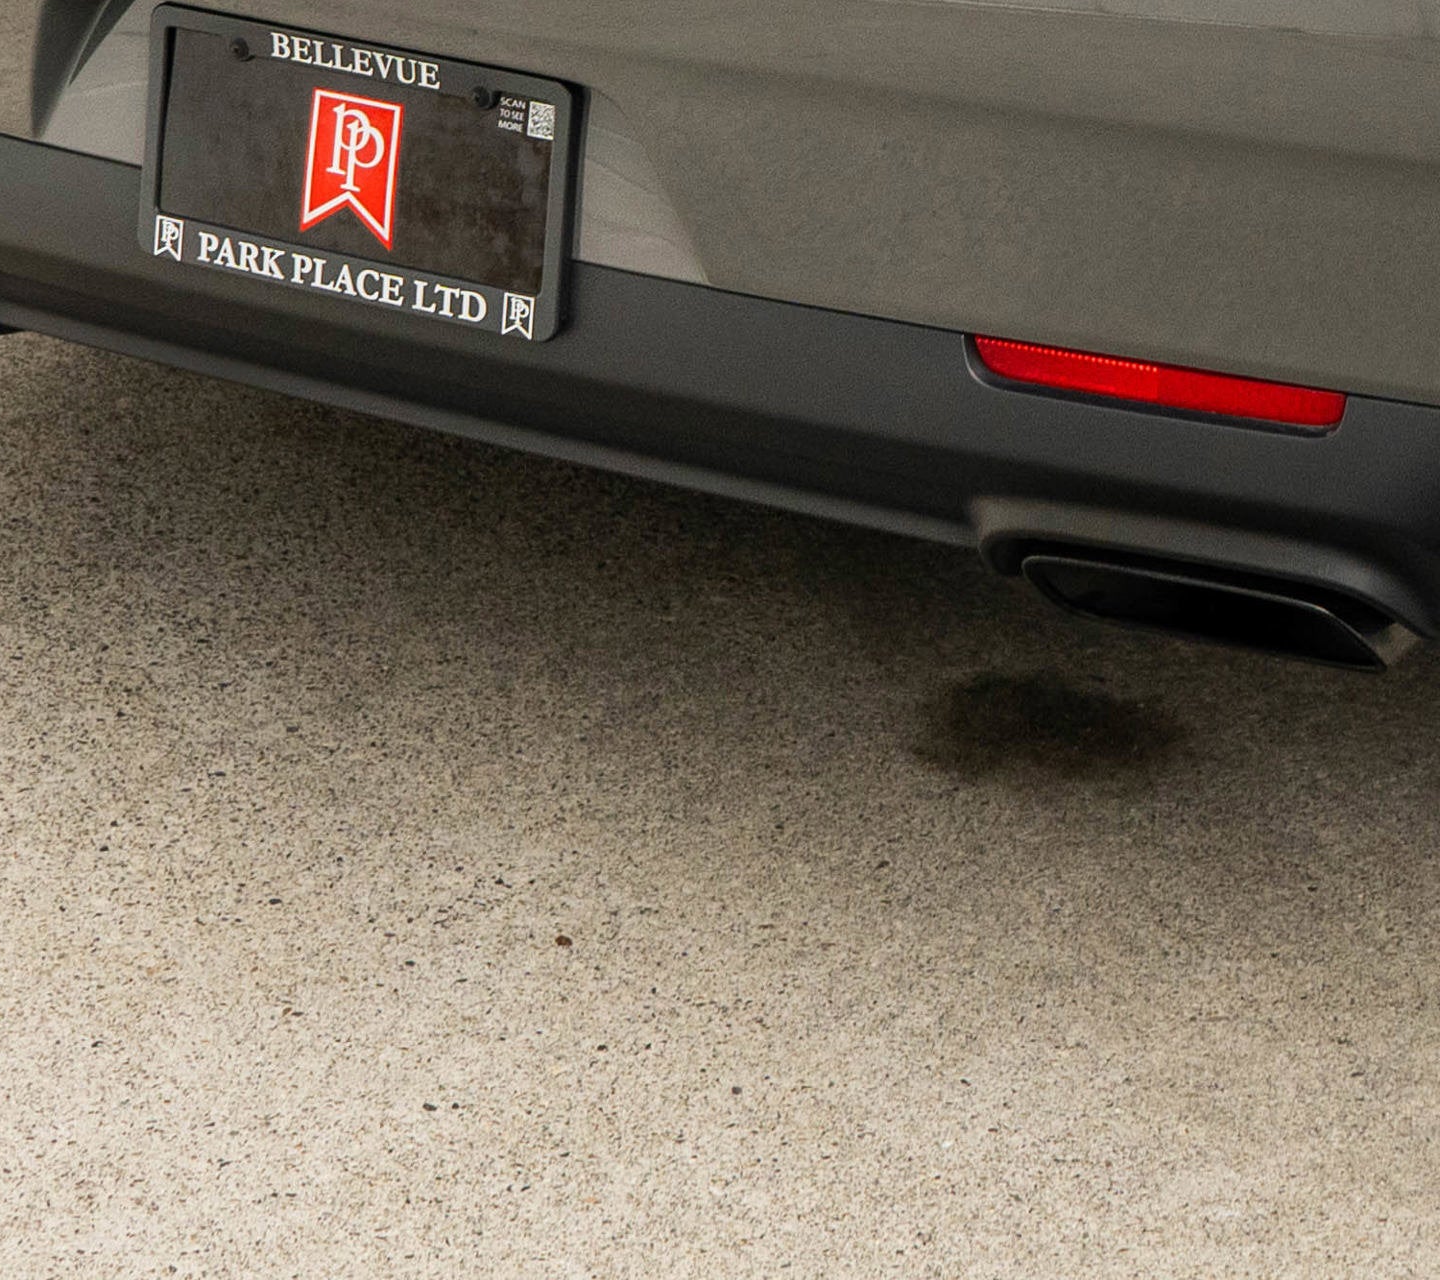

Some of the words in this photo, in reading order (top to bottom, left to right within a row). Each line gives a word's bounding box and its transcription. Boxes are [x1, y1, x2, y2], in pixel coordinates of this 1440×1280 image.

[270, 31, 441, 90] BELLEVUE
[500, 96, 527, 110] SCAN
[500, 108, 511, 118] TO
[497, 119, 524, 133] MORE
[197, 231, 286, 280] PARK
[290, 252, 405, 307] PLACE
[411, 280, 488, 323] LTD
